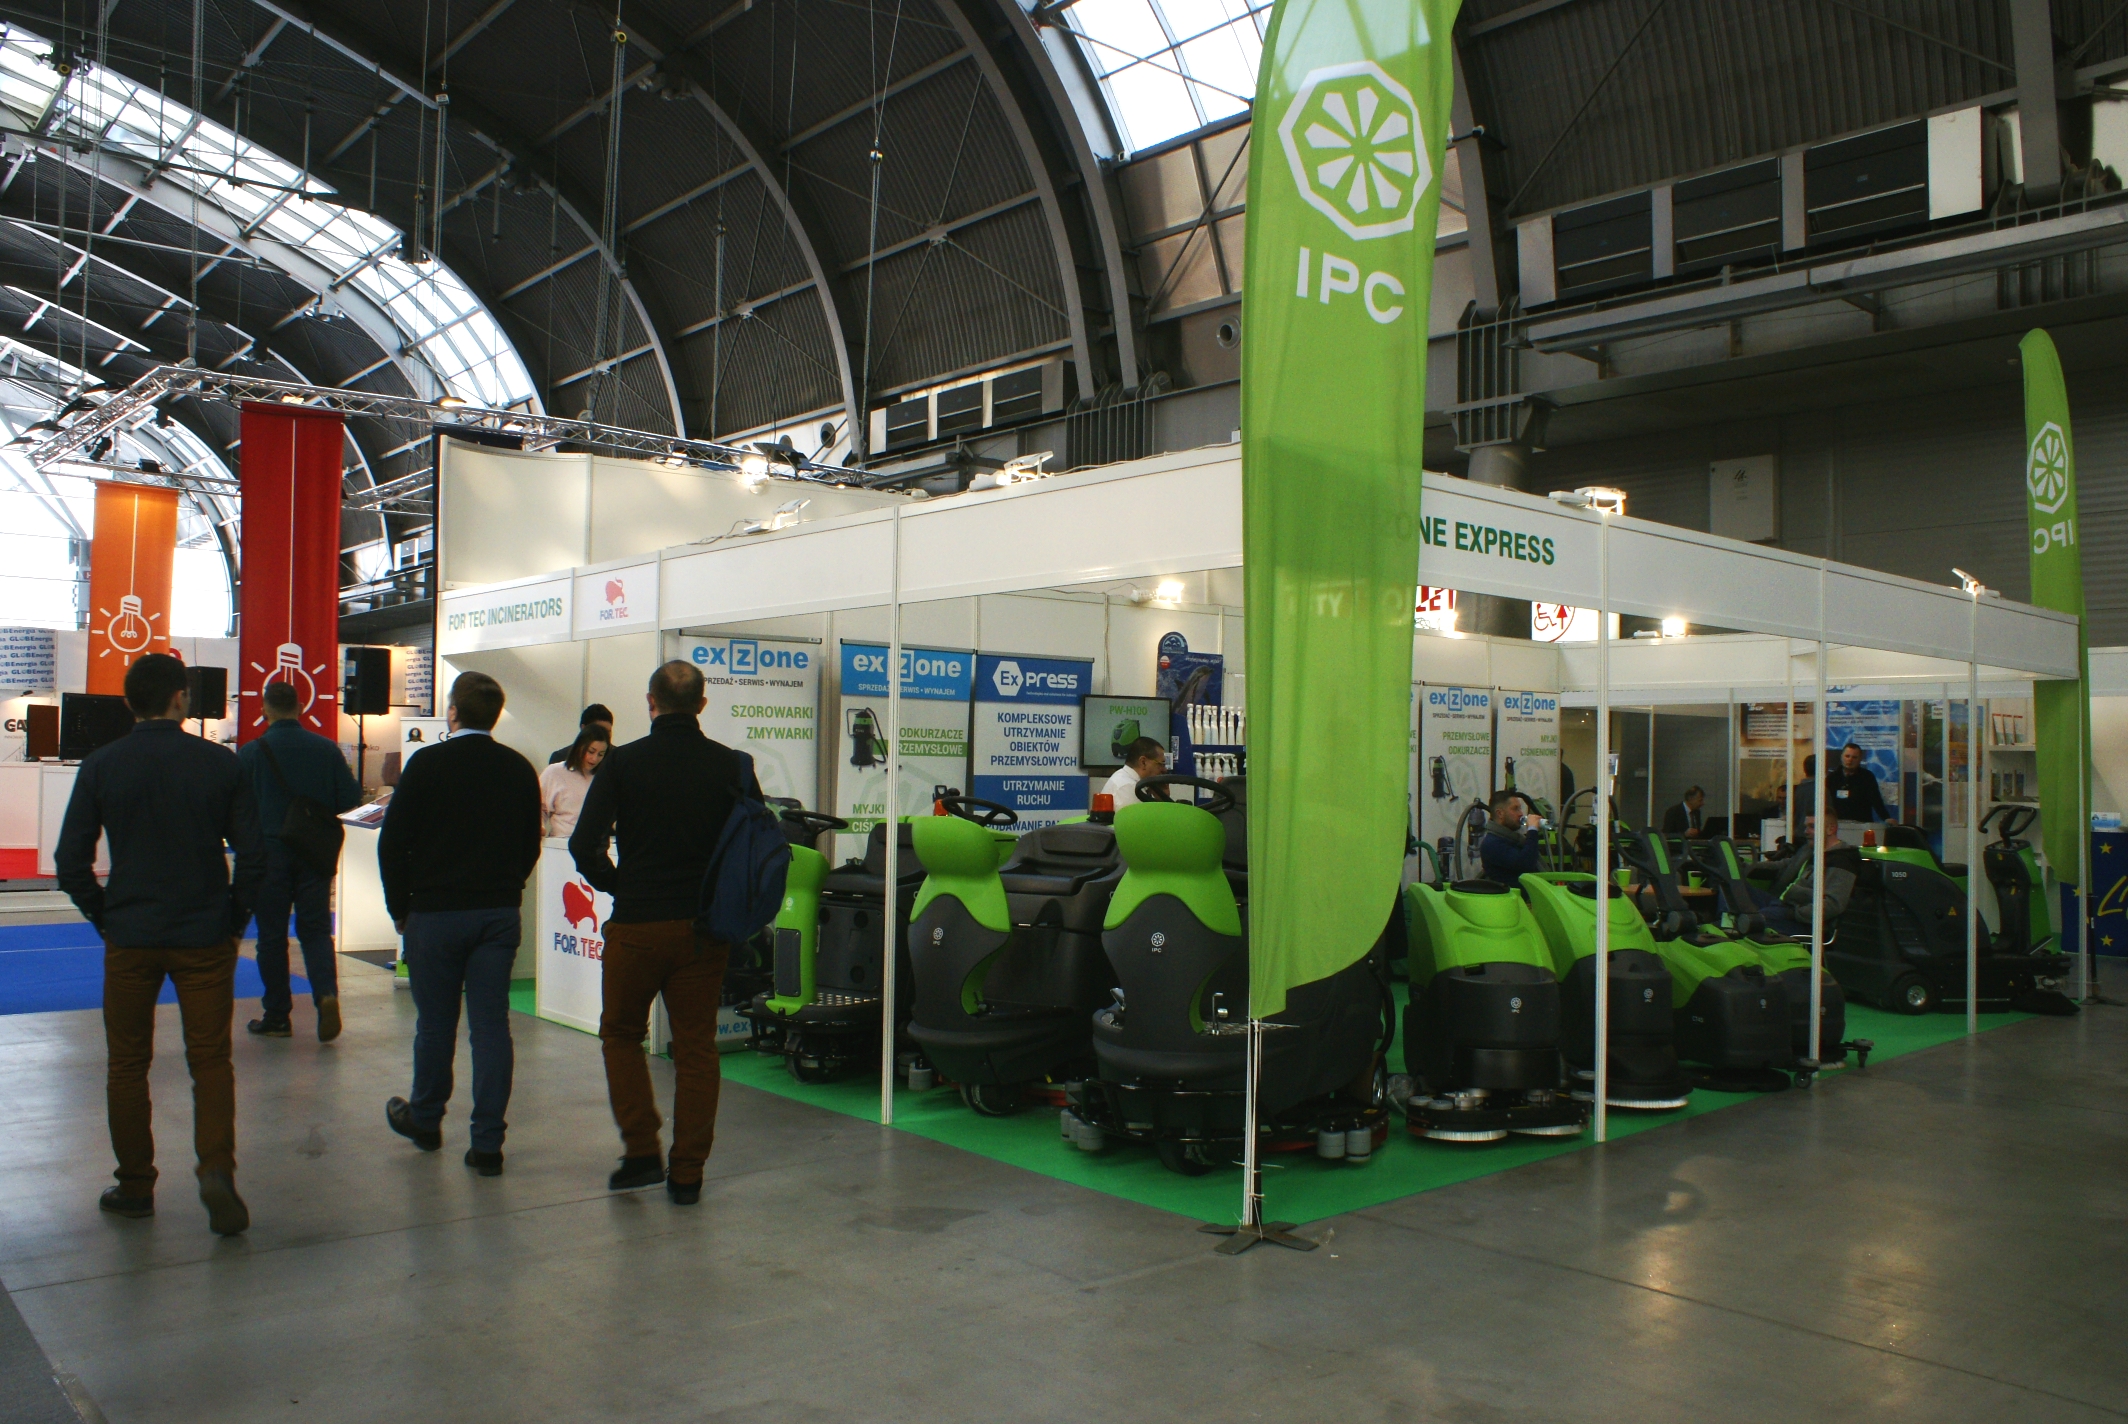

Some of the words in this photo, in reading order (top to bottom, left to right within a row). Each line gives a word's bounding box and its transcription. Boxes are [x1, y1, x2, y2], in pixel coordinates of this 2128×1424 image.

[1296, 246, 1405, 324] IPC
[1454, 521, 1555, 566] EXPRESS
[448, 613, 466, 631] FOR
[468, 609, 486, 628] TEC
[487, 597, 562, 626] INCINERATORS
[692, 642, 809, 672] exzone
[703, 677, 734, 686] PRZEDAŻ
[738, 679, 764, 687] SERWIS
[769, 680, 804, 688] WYNAJEM
[900, 686, 920, 694] ERWIS
[924, 687, 955, 696] WYNAJEM
[1429, 690, 1488, 709] exzone
[1504, 694, 1556, 712] exzone
[731, 705, 813, 719] SZOROWARKI
[1109, 705, 1148, 716] PW-H100
[998, 712, 1072, 725] KOMPLEKSOWE
[746, 727, 813, 740] ZMYWARKI
[900, 728, 963, 740] ODKURZACZE
[1004, 727, 1066, 738] UTRZYMANIE
[1442, 731, 1490, 741] PRZEMYSŁOWE
[898, 743, 963, 755] RZEMYSŁOWE
[1010, 740, 1060, 752] OBIEKTÓW
[1448, 746, 1490, 755] ODKURZACZE
[991, 755, 1077, 766] PRZEMYSŁOWYCH
[1003, 780, 1065, 791] UTRZYMANIE
[1017, 794, 1051, 805] RUCHU
[852, 804, 885, 815] MYJKI
